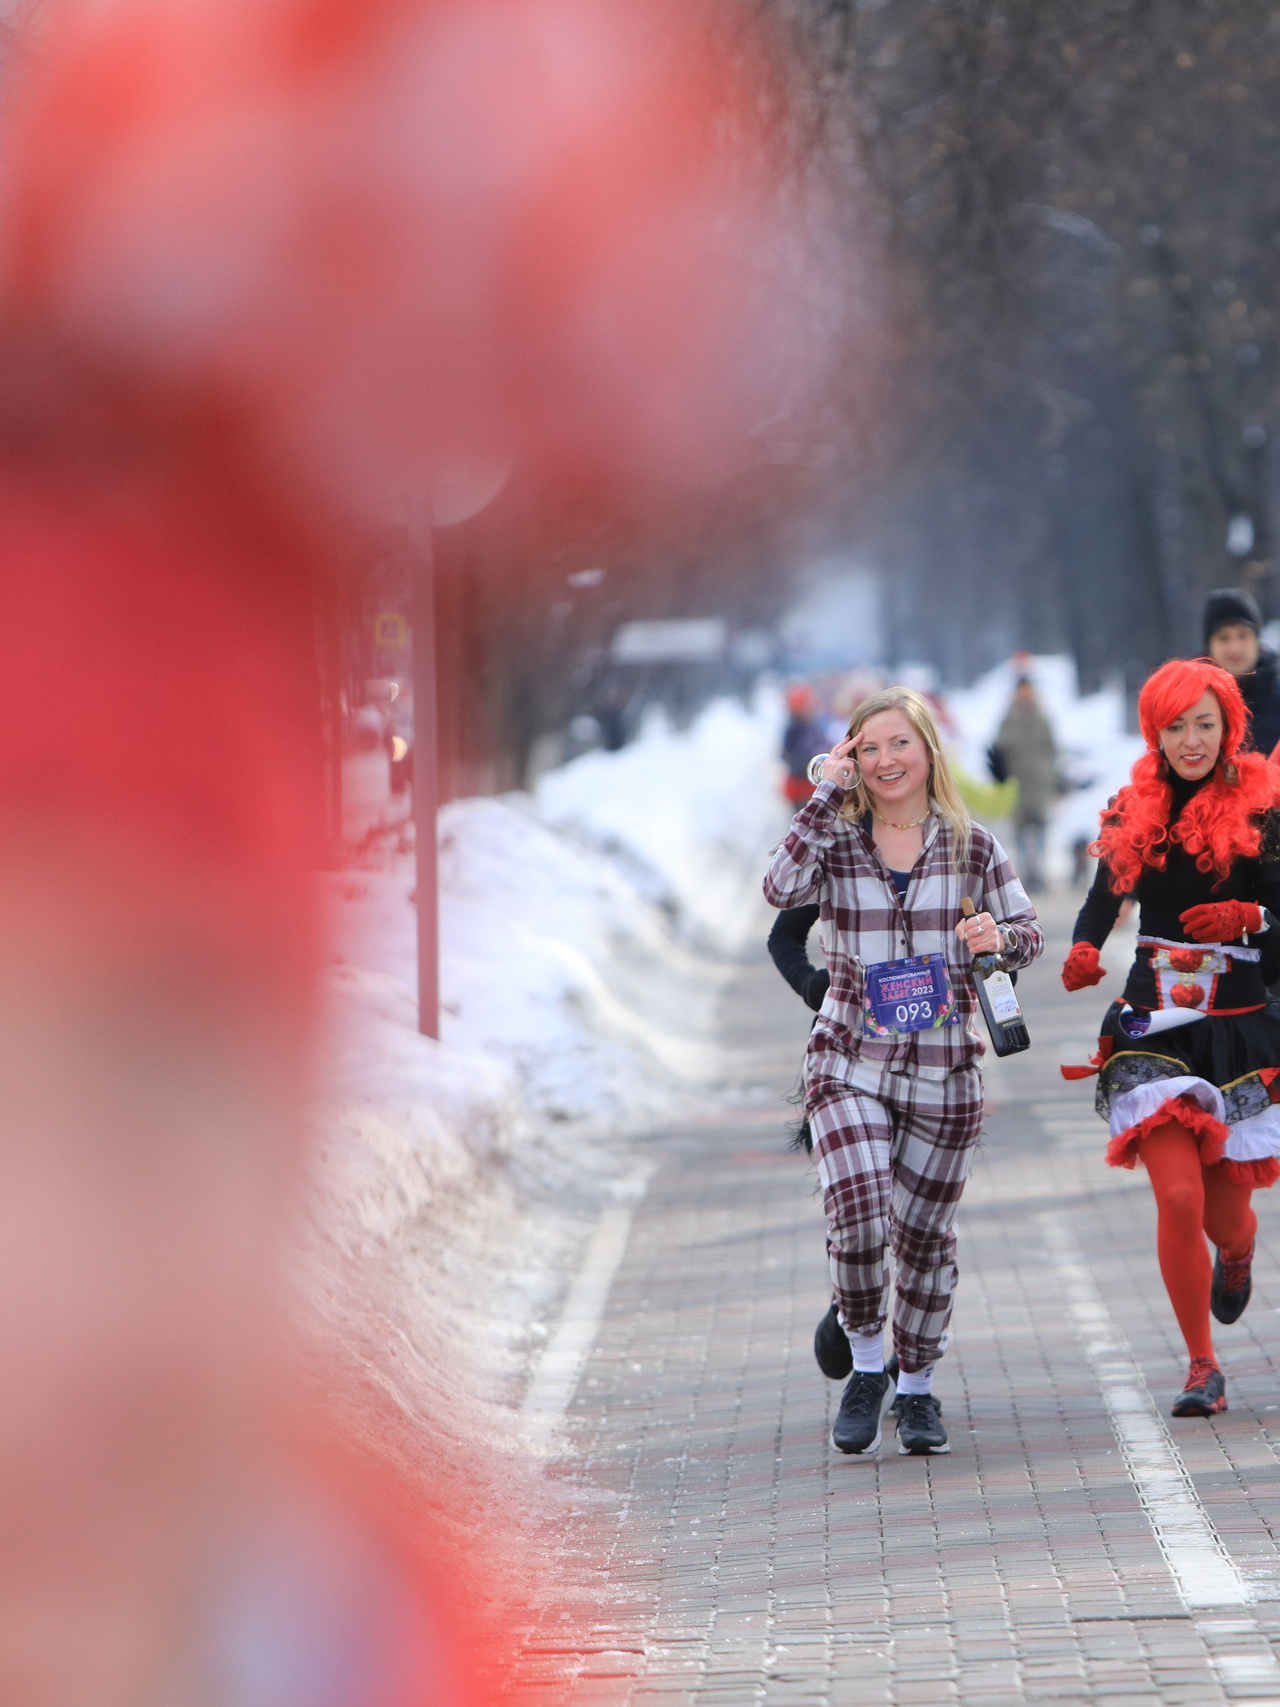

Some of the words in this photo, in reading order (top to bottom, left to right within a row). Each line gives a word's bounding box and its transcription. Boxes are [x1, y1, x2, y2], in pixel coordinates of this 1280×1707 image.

[878, 968, 931, 983] КОСТЮМИРОВАННЫЙ
[880, 974, 933, 993] ЖЕНСКИЙ
[881, 988, 909, 1002] ЗАБЕГ
[911, 984, 934, 996] 2023
[895, 1000, 932, 1022] 093
